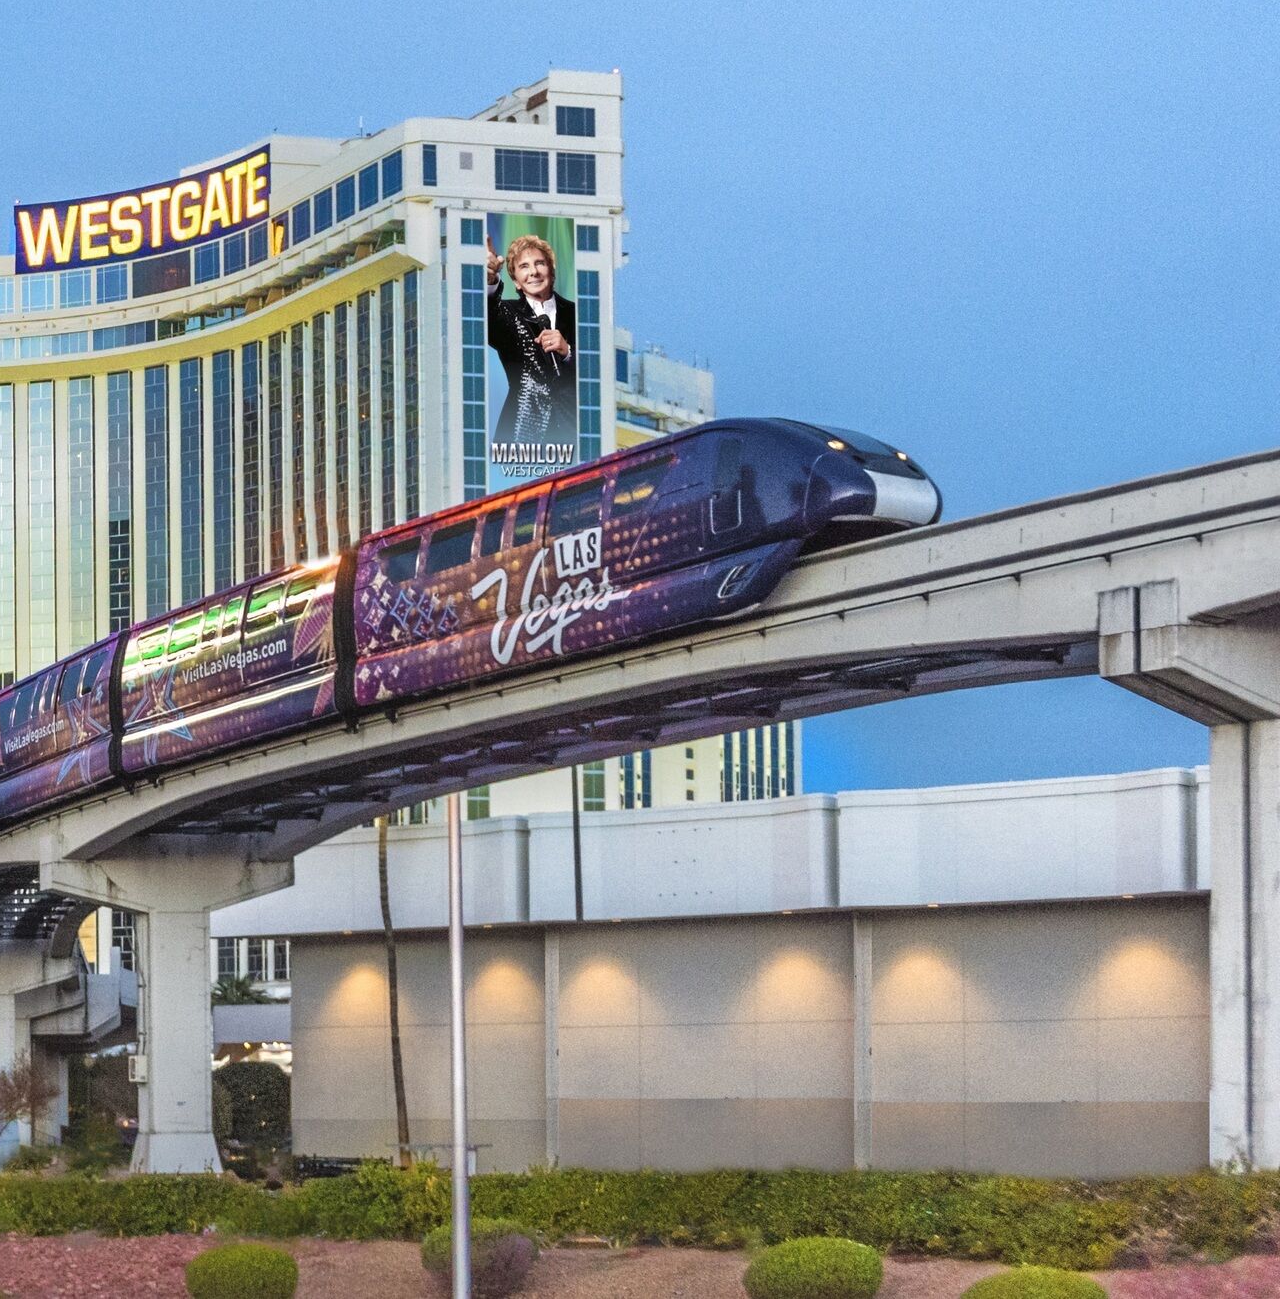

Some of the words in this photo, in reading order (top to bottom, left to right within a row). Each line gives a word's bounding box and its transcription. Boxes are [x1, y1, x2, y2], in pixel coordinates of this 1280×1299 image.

[17, 152, 268, 267] WESTGATE
[491, 442, 574, 464] MANILOW
[559, 532, 597, 571] LAS
[471, 547, 632, 665] Vegas
[182, 639, 287, 685] VisitLasVegas.com
